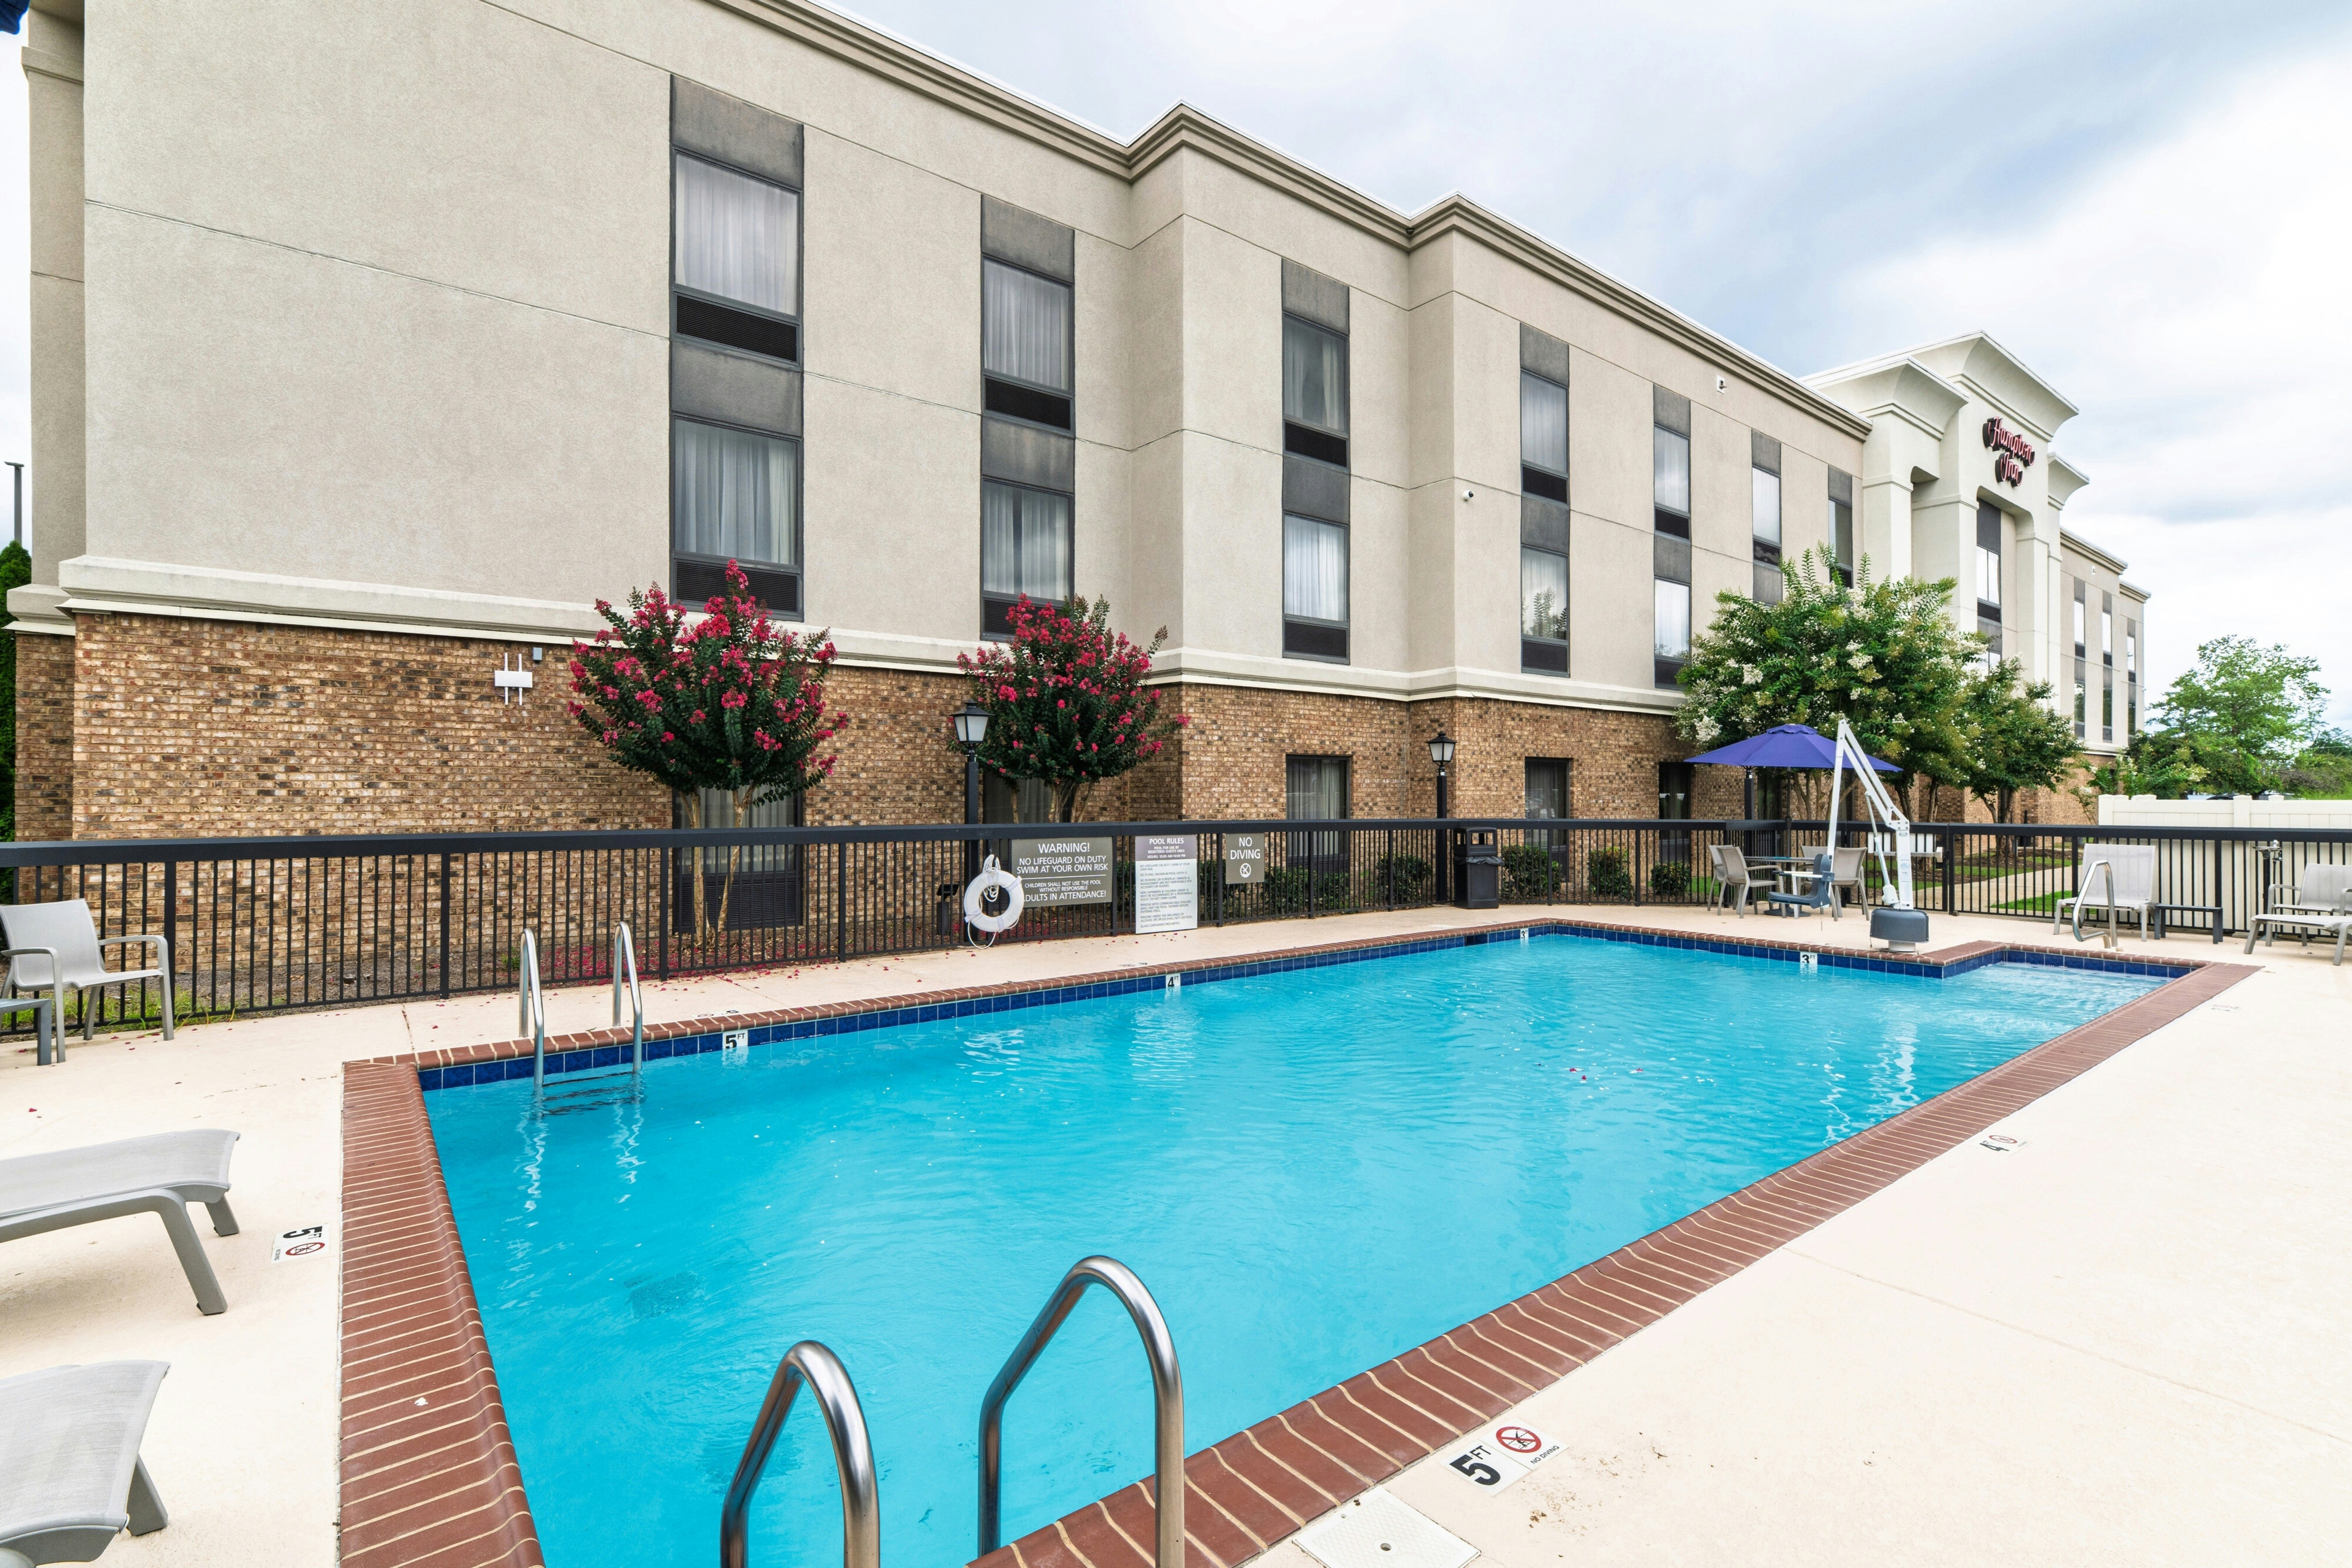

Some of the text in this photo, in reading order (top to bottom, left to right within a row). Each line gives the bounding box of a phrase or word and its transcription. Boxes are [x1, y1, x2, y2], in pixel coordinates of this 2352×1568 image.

[1984, 416, 2035, 466] Hampton
[1997, 452, 2022, 486] Inn
[1239, 837, 1252, 846] NO
[1038, 843, 1090, 853] WARNING!
[1231, 849, 1260, 860] DIVING
[1033, 857, 1072, 865] LIFEGUARD
[1025, 893, 1047, 902] DULTS
[1059, 890, 1106, 900] ATTENDANCE!
[1802, 955, 1809, 963] 3
[1168, 977, 1174, 987] 4
[726, 1034, 737, 1049] 5
[283, 1226, 323, 1238] 5
[1540, 1446, 1559, 1458] DIVING
[1449, 1445, 1501, 1486] 5 FT
